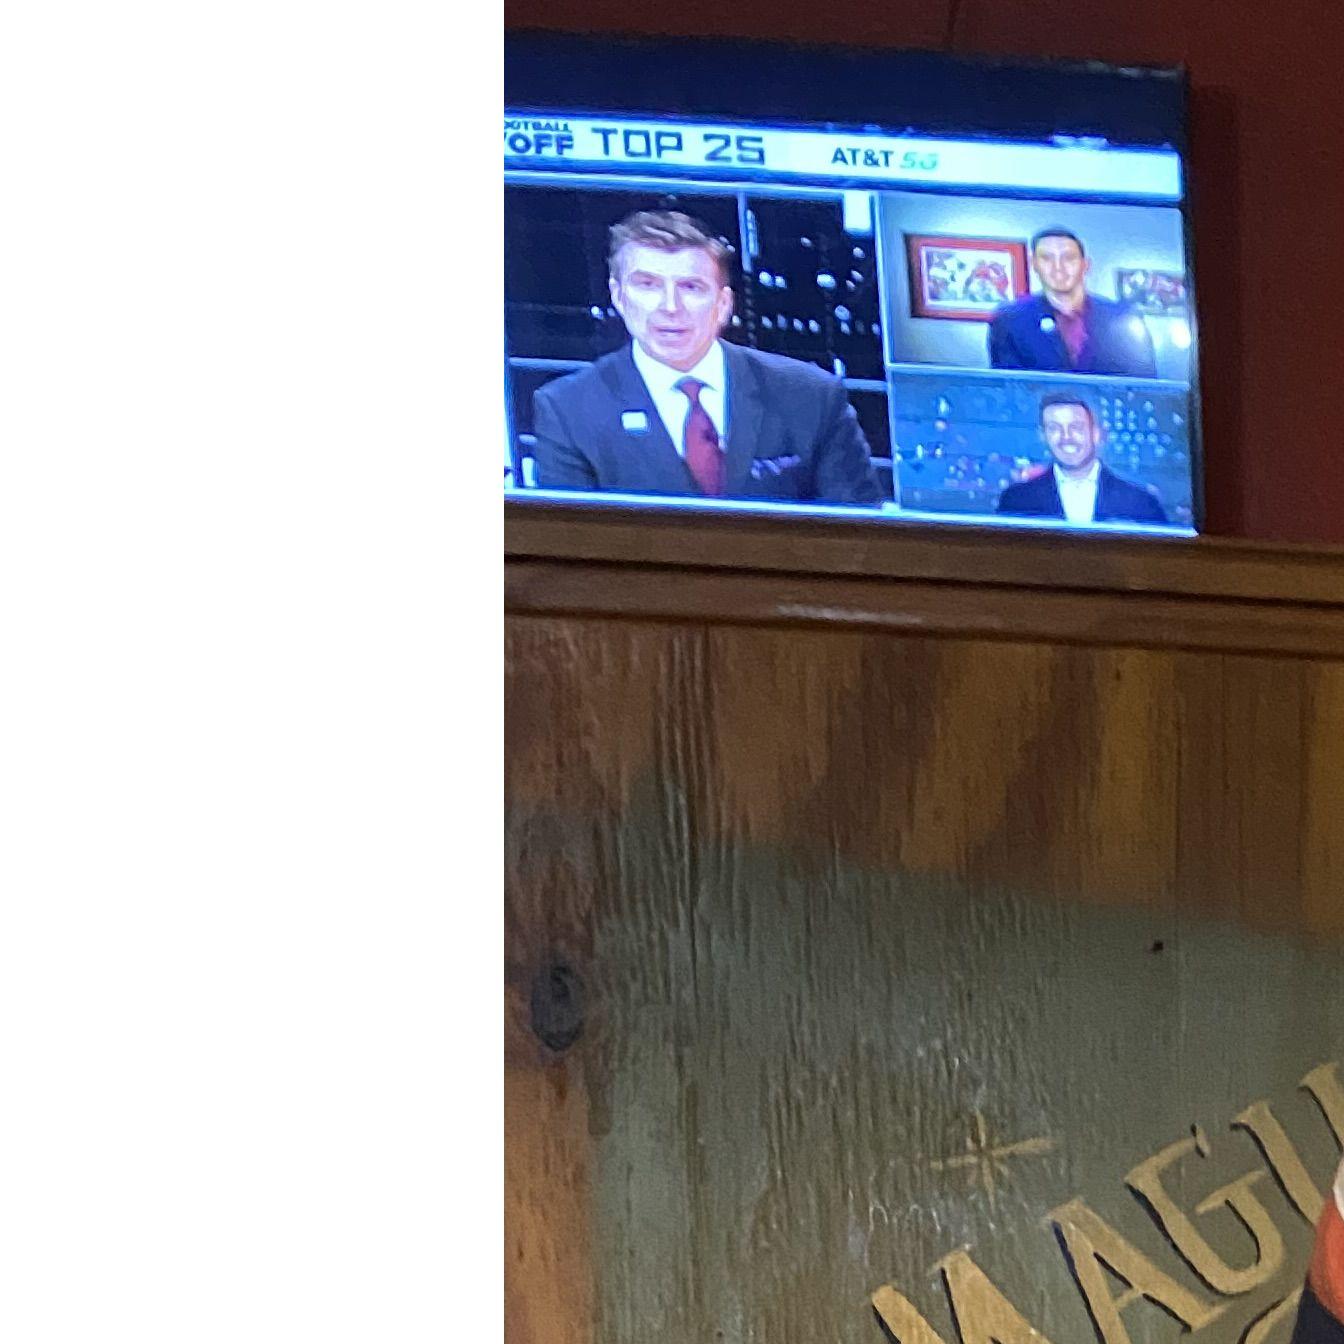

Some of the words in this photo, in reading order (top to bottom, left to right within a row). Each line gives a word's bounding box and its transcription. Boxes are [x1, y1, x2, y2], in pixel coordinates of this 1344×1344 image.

[504, 132, 574, 155] OFF
[591, 127, 683, 159] TOP
[703, 132, 765, 165] 25
[830, 146, 895, 168] AT&T
[900, 150, 939, 170] 5G
